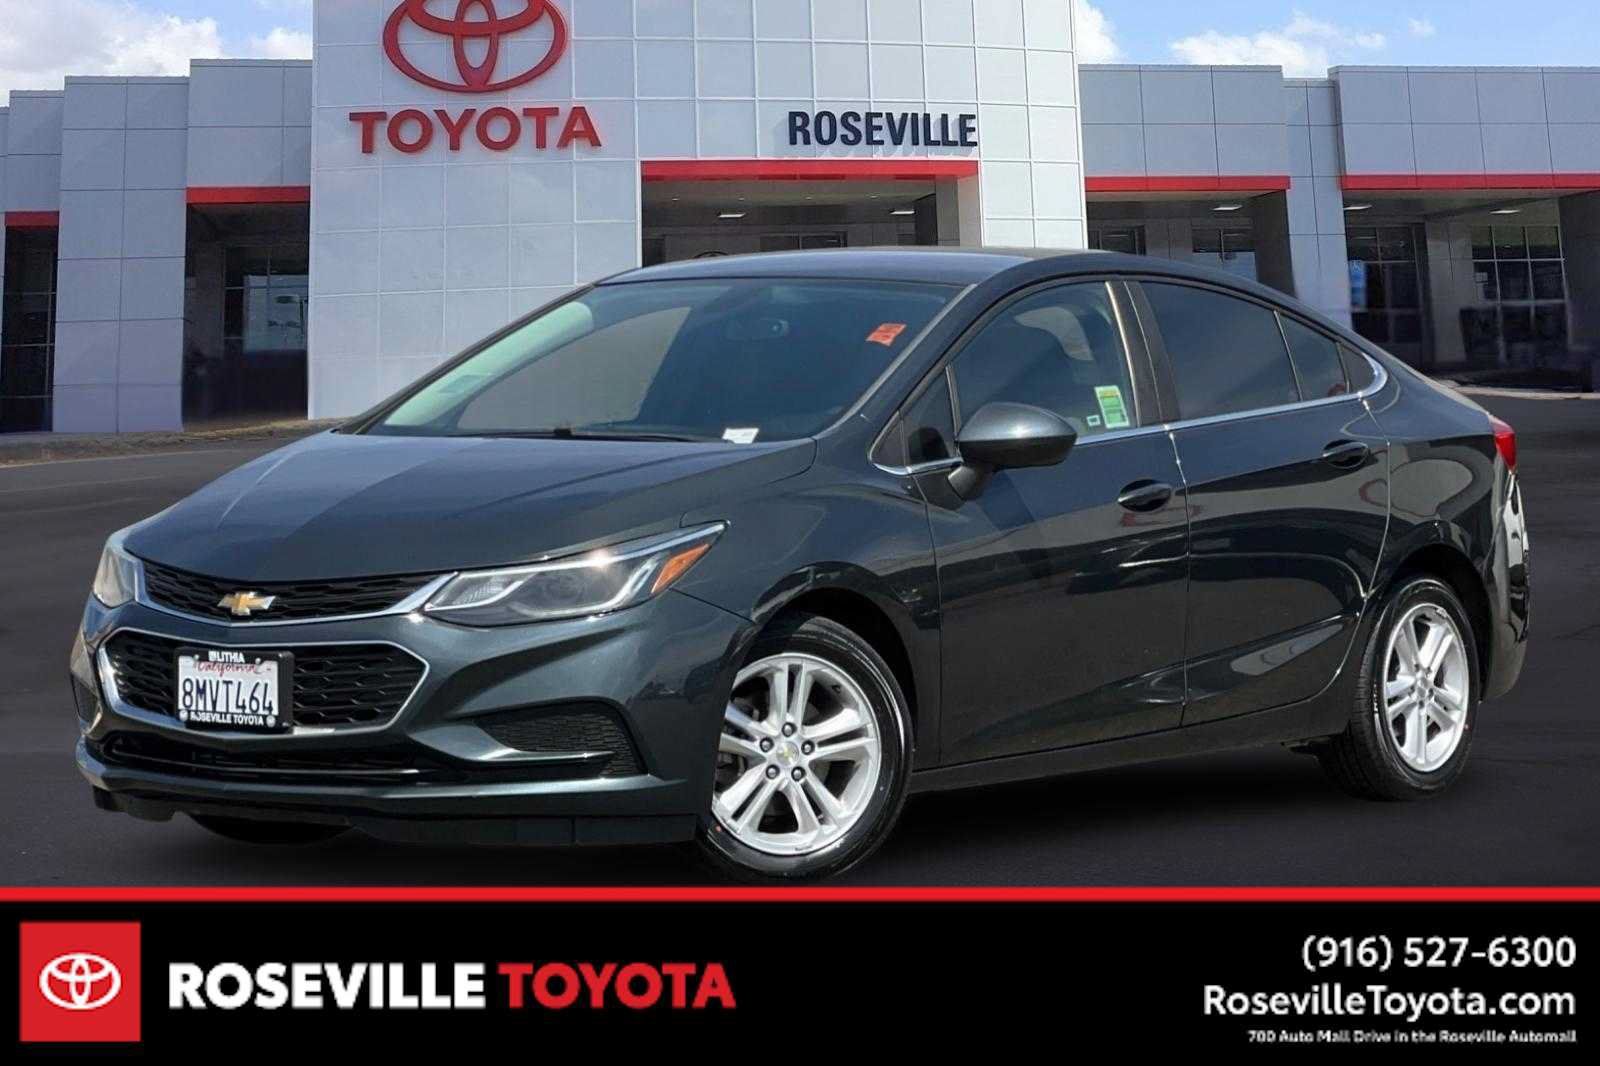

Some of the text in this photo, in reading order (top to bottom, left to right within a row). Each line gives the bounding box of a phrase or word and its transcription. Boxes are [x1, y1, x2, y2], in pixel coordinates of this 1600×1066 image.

[349, 106, 602, 154] TOYOTA
[788, 110, 979, 147] ROSEVILLE
[215, 651, 246, 663] LITHIA
[182, 678, 274, 714] 8MVT464
[190, 711, 265, 726] ROSEVILLE TOYOTA
